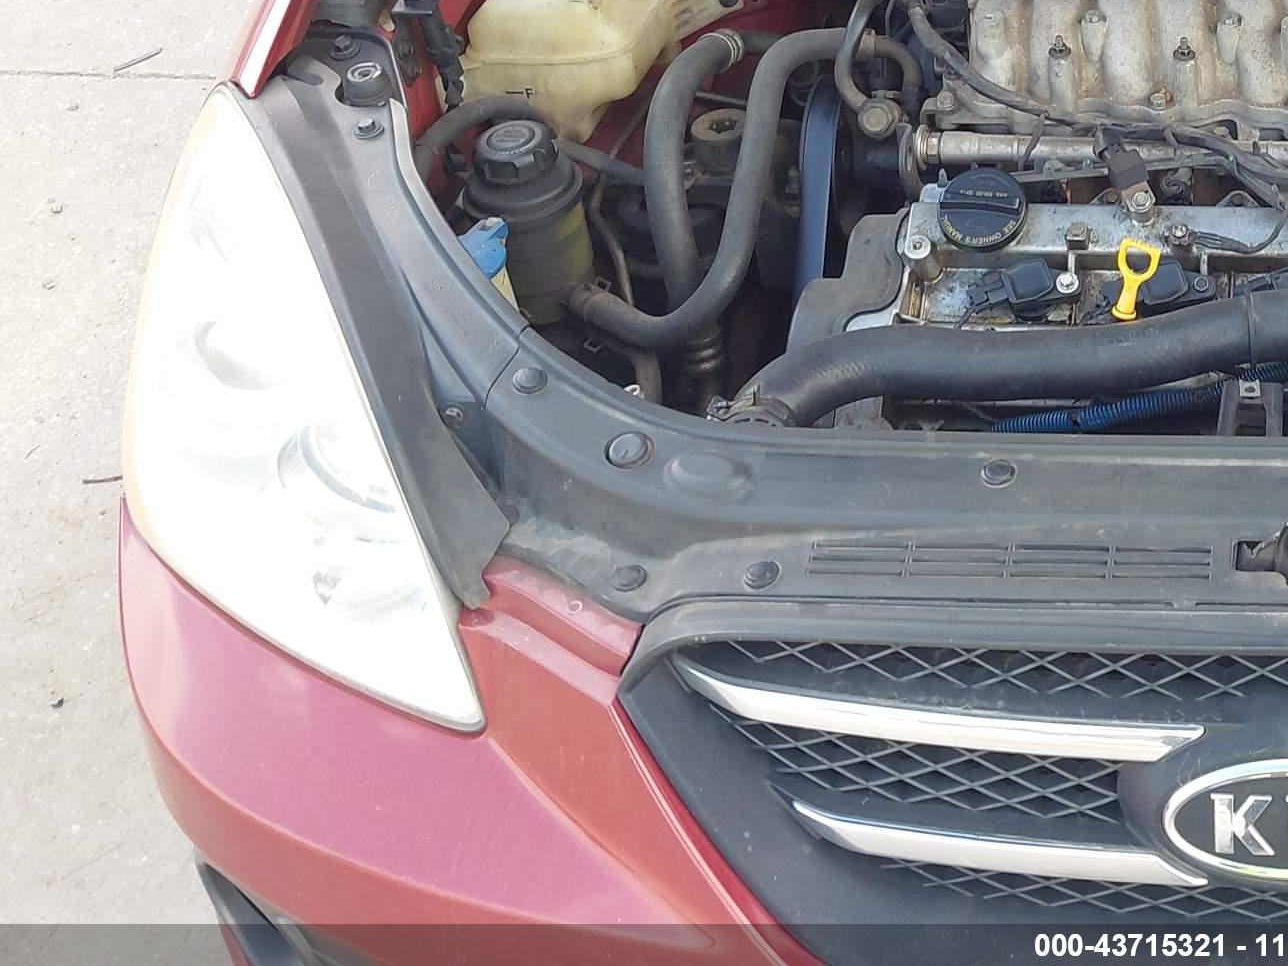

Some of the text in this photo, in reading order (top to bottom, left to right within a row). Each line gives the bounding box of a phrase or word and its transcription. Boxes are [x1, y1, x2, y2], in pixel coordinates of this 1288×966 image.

[941, 214, 1017, 245] SEE OWNER'S MANUAL
